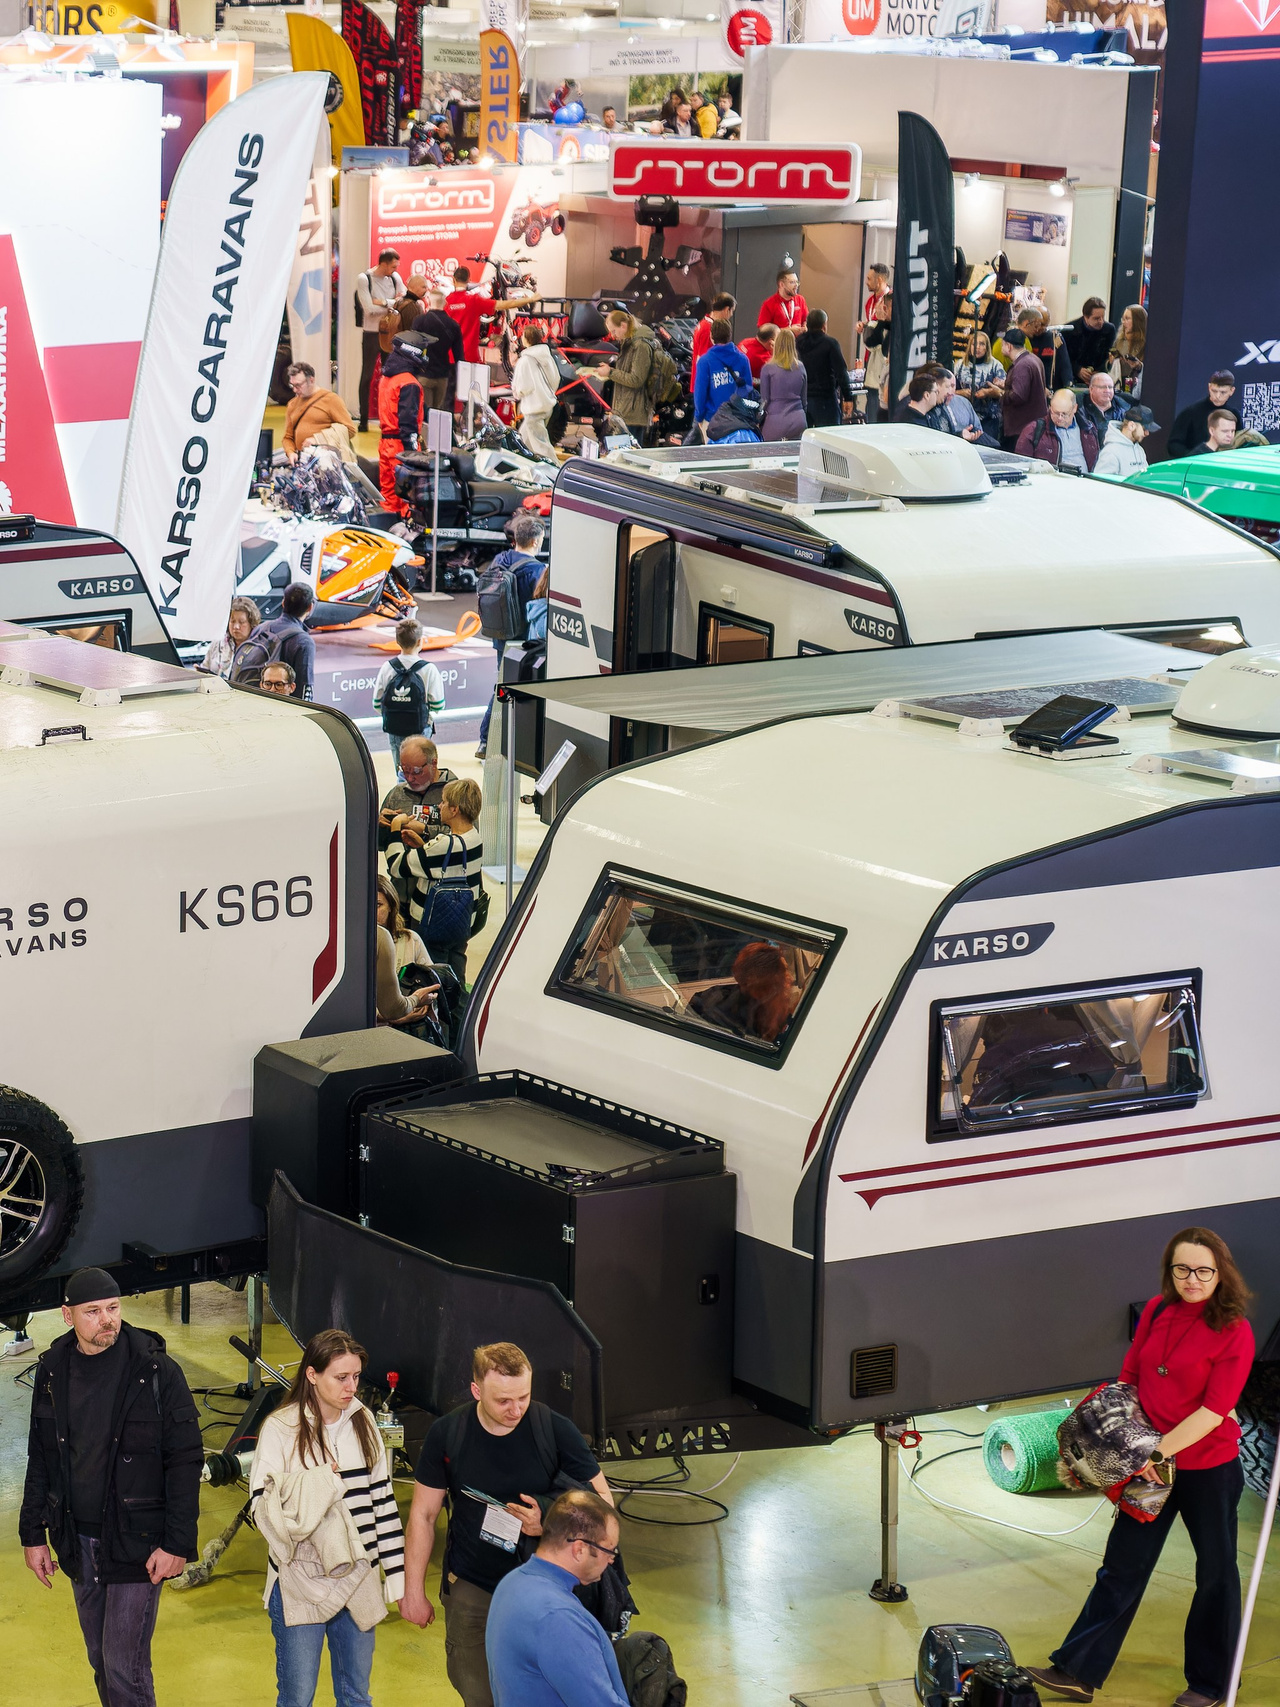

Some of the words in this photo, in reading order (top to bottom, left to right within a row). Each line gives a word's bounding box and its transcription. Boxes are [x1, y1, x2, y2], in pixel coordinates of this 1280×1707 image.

[904, 220, 929, 384] RKUT
[159, 435, 209, 617] KARSO
[191, 132, 264, 423] CARAVANS
[793, 548, 814, 561] KARSO
[70, 576, 135, 597] KARSO
[551, 612, 584, 638] KS42
[850, 614, 896, 641] KARSO
[179, 875, 314, 933] KS66
[933, 931, 1030, 961] KARSO
